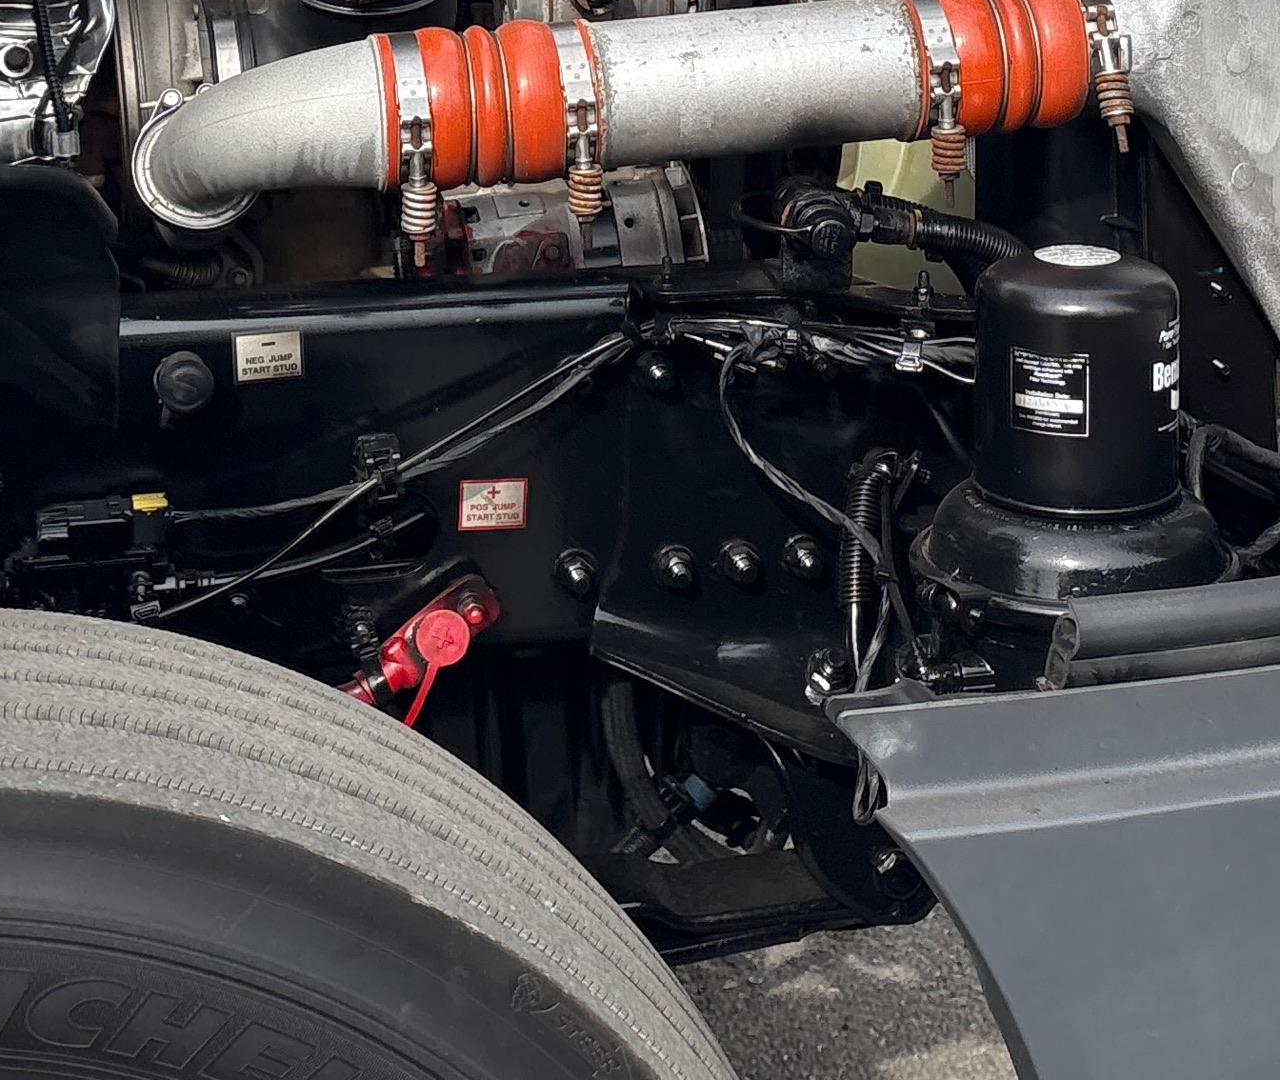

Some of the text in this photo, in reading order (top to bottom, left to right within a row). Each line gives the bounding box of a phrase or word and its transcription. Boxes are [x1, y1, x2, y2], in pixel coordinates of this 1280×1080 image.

[245, 353, 293, 365] NEG JUMP
[241, 366, 271, 376] START
[272, 363, 298, 373] STUD
[492, 503, 516, 511] JUMP
[496, 512, 520, 520] STUD
